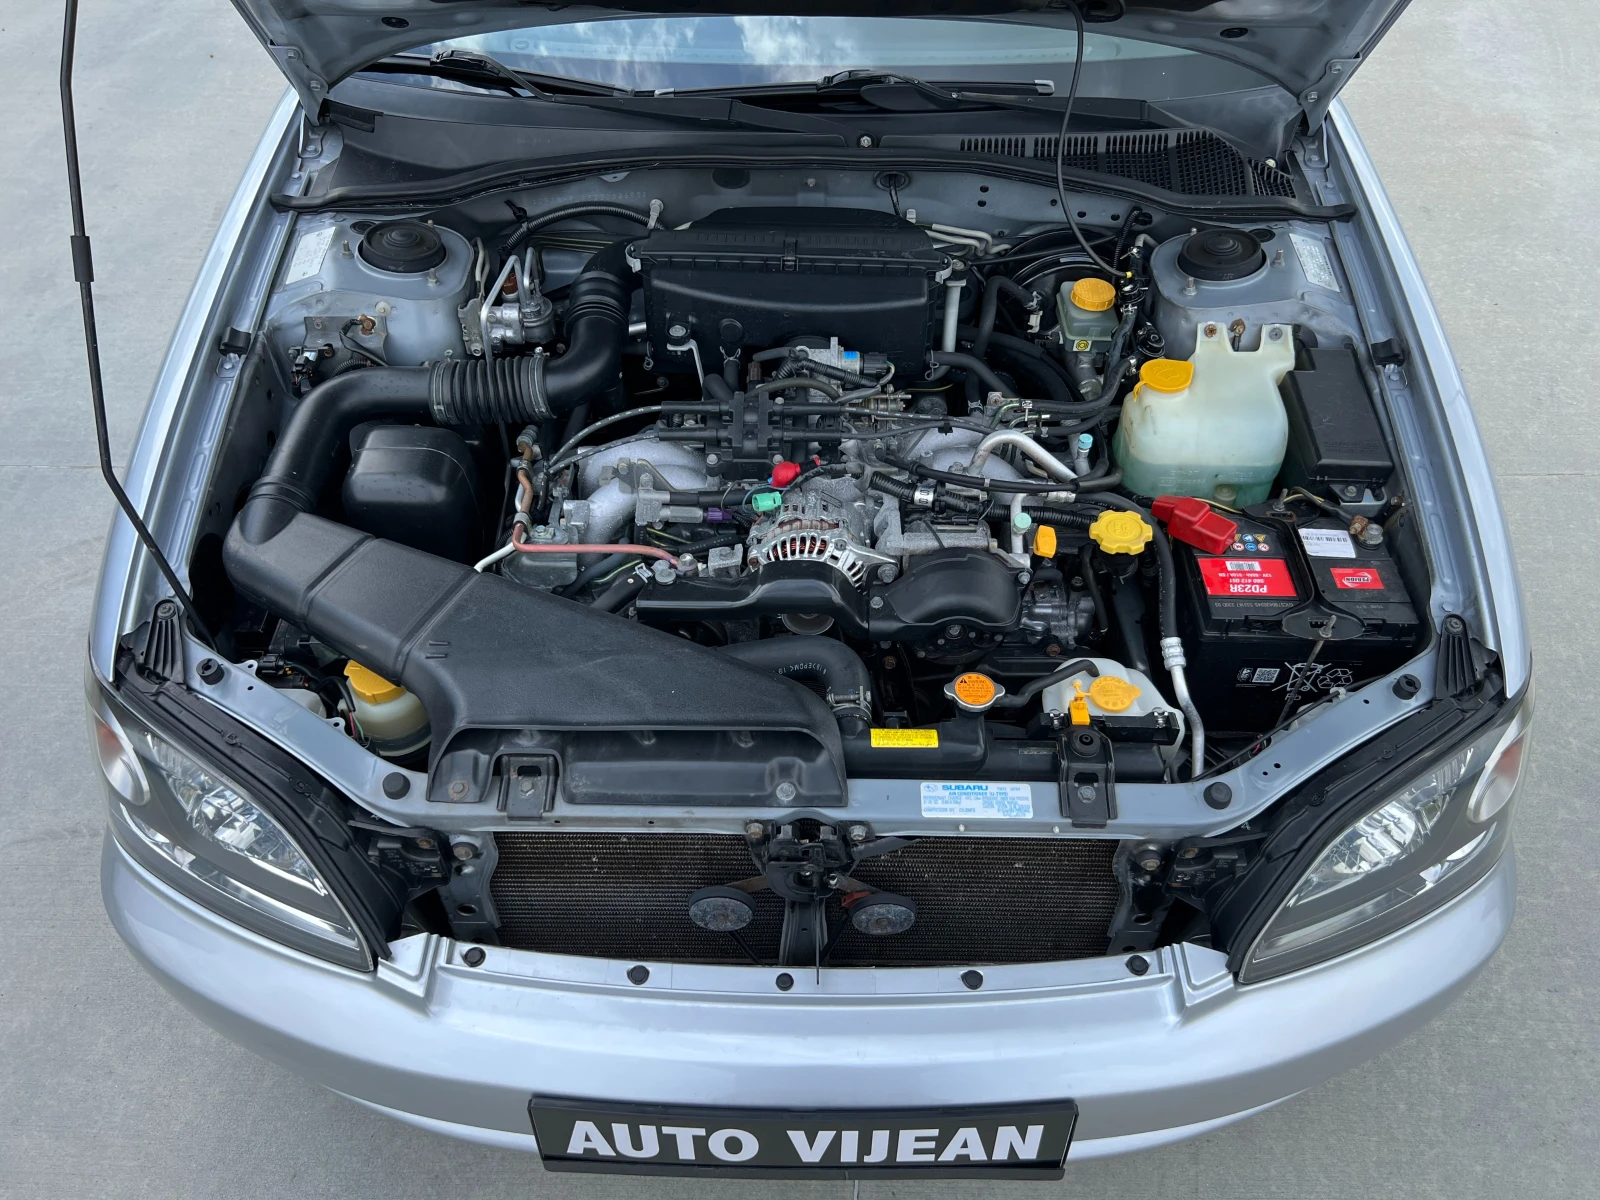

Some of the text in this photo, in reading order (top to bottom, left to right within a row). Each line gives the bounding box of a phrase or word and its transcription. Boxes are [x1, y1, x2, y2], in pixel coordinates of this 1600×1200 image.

[1229, 584, 1267, 593] PD23R
[566, 1119, 1045, 1164] AUTO VIJEAN
